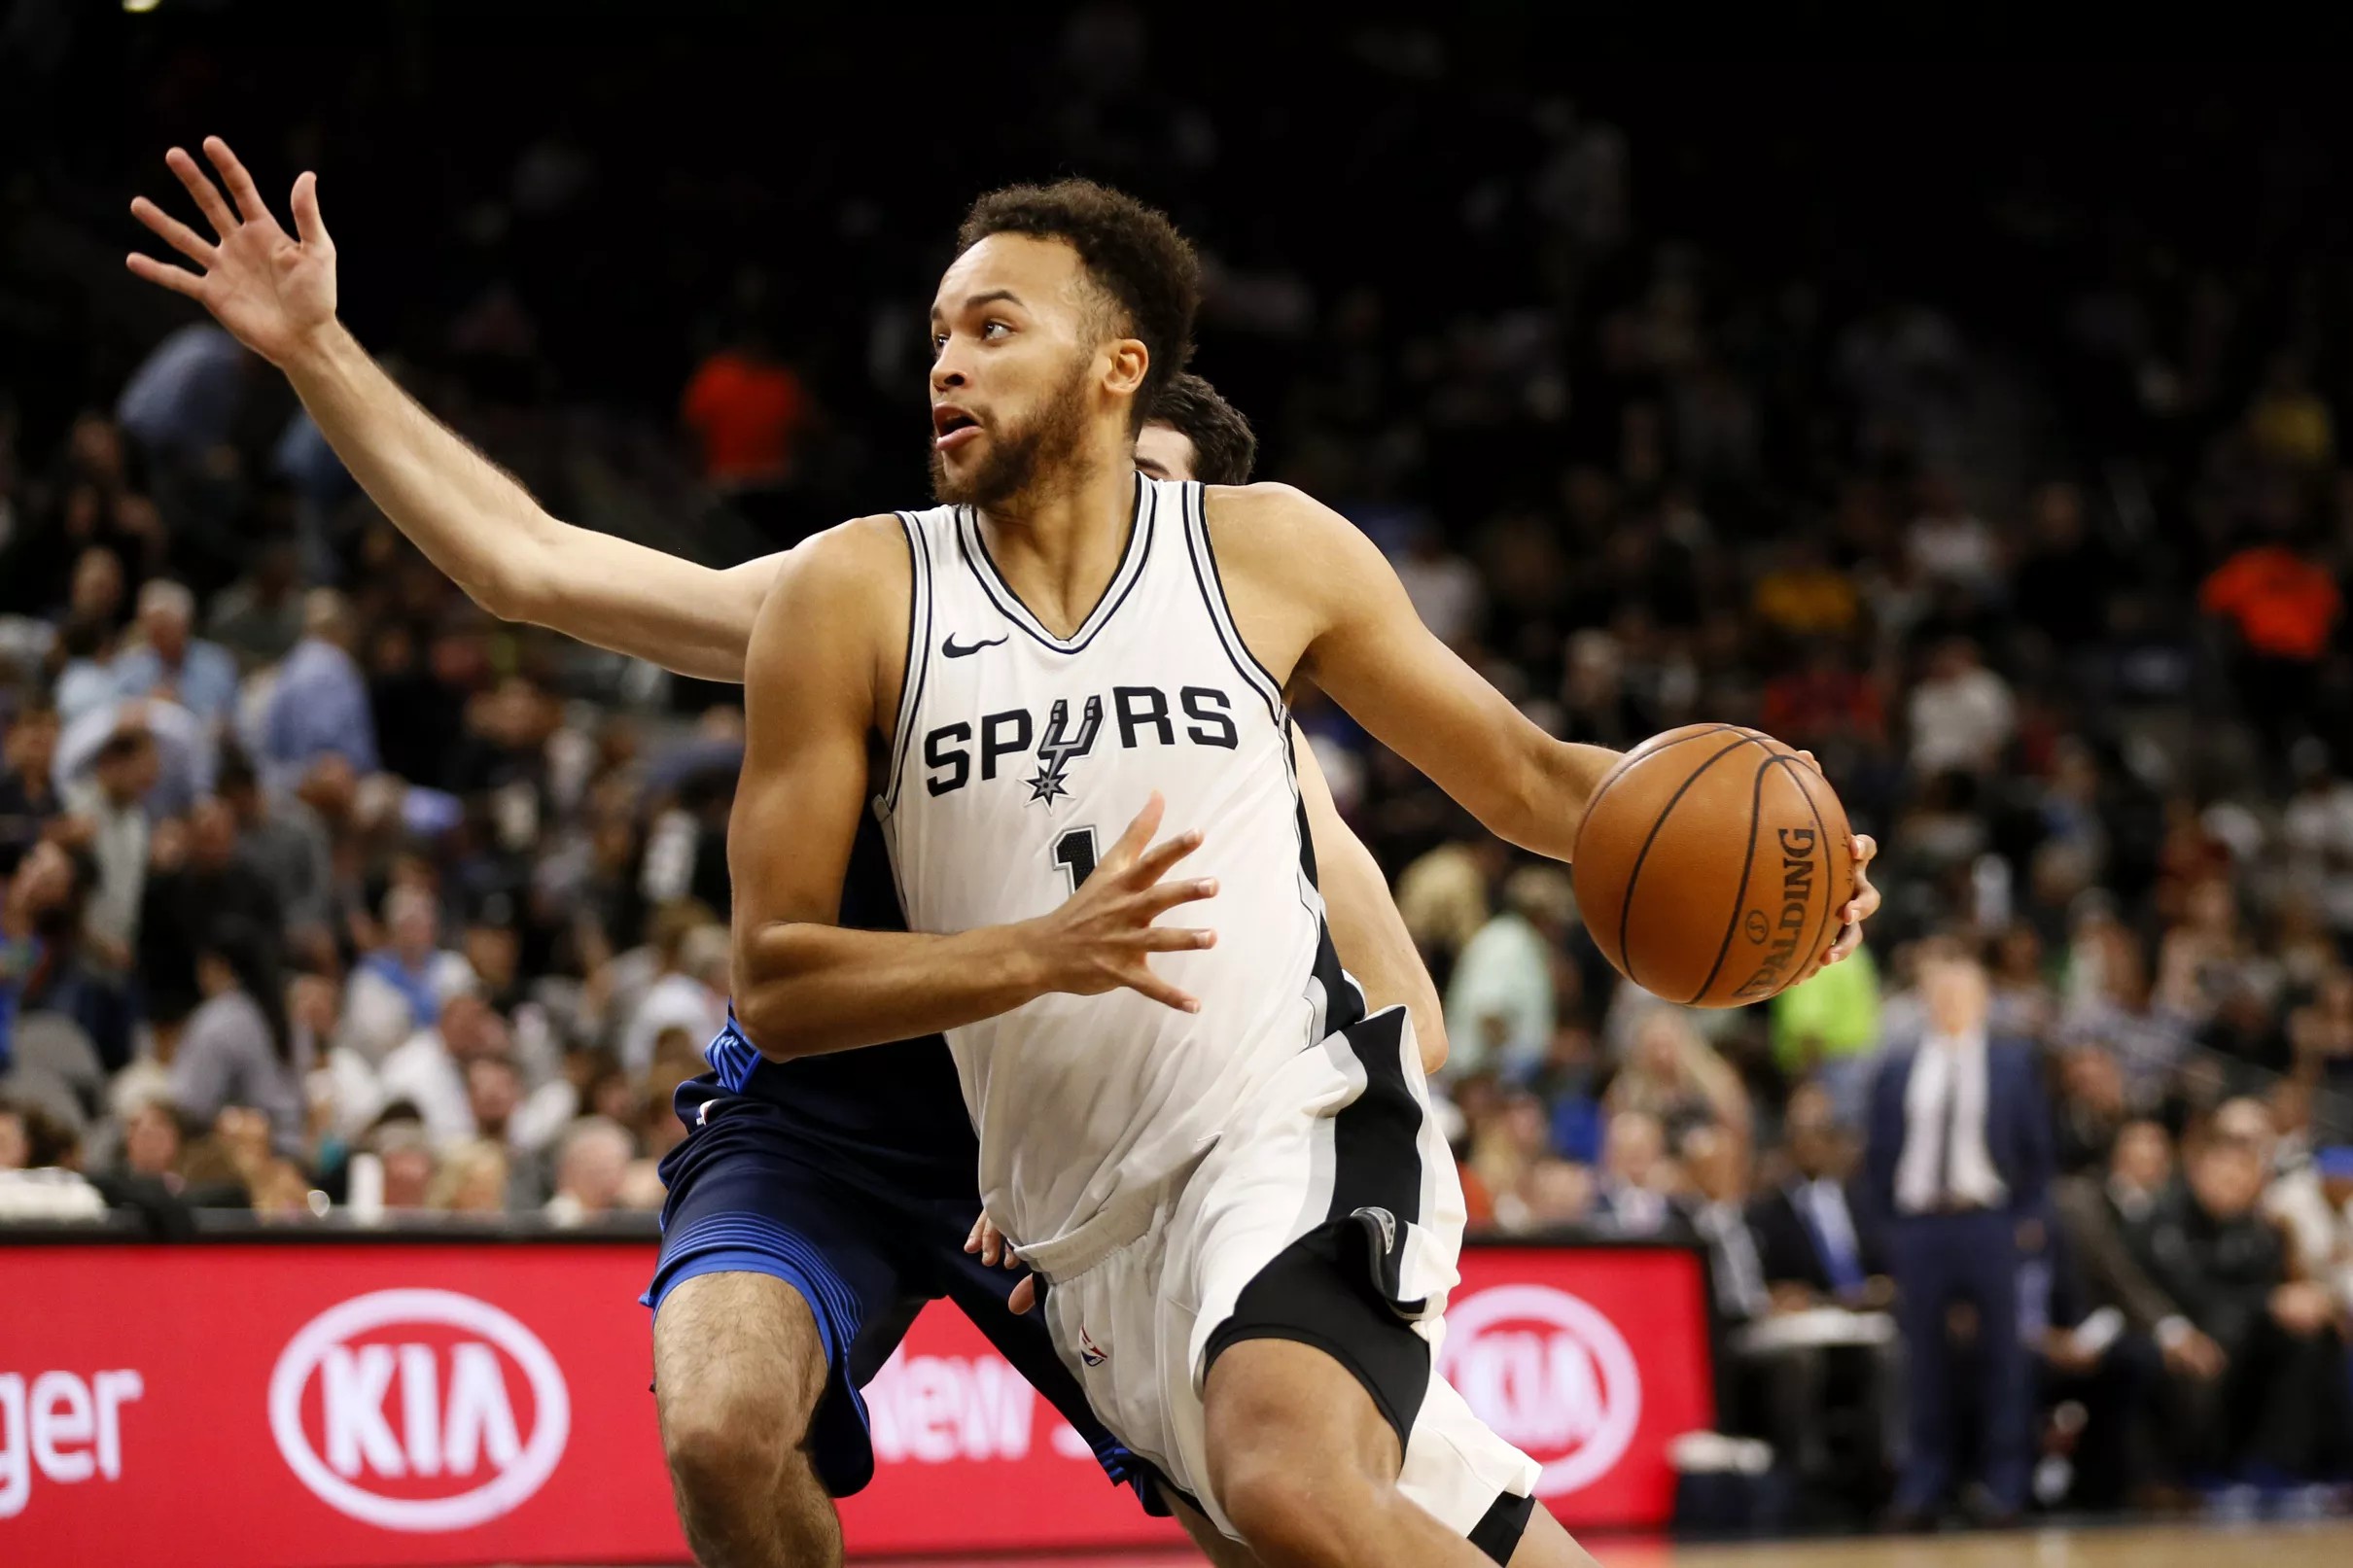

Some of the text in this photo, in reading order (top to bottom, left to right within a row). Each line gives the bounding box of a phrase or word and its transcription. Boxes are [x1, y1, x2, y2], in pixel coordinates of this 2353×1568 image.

[925, 685, 1239, 814] SPURS
[1050, 824, 1101, 895] 1
[1734, 828, 1815, 996] SPALDING
[319, 1342, 524, 1479] KIA
